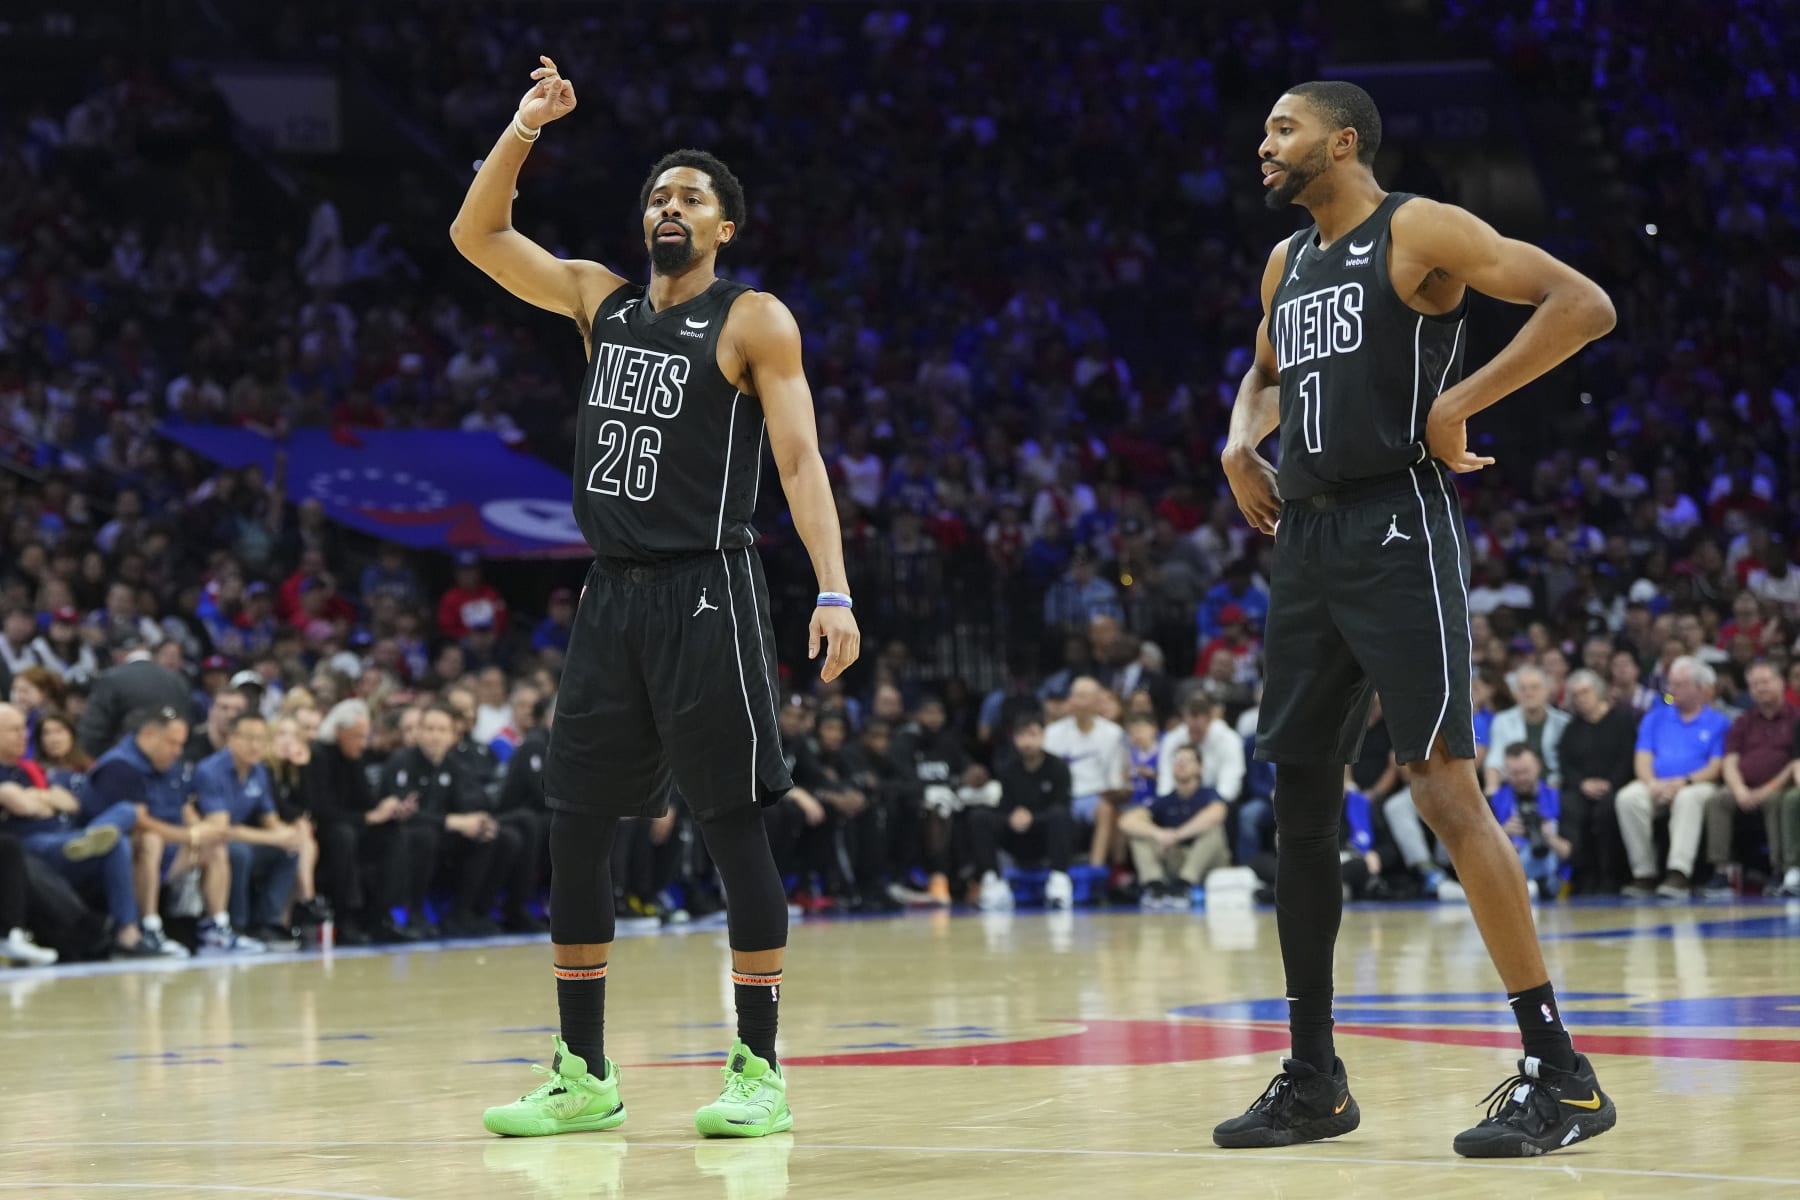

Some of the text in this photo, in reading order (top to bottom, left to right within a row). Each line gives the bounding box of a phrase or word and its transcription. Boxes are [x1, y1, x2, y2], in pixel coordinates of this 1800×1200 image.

[1345, 257, 1369, 267] Webull
[680, 329, 704, 339] Webull
[1276, 282, 1364, 373] NETS
[588, 342, 690, 419] NETS
[1300, 372, 1322, 453] 1
[586, 420, 662, 501] 26
